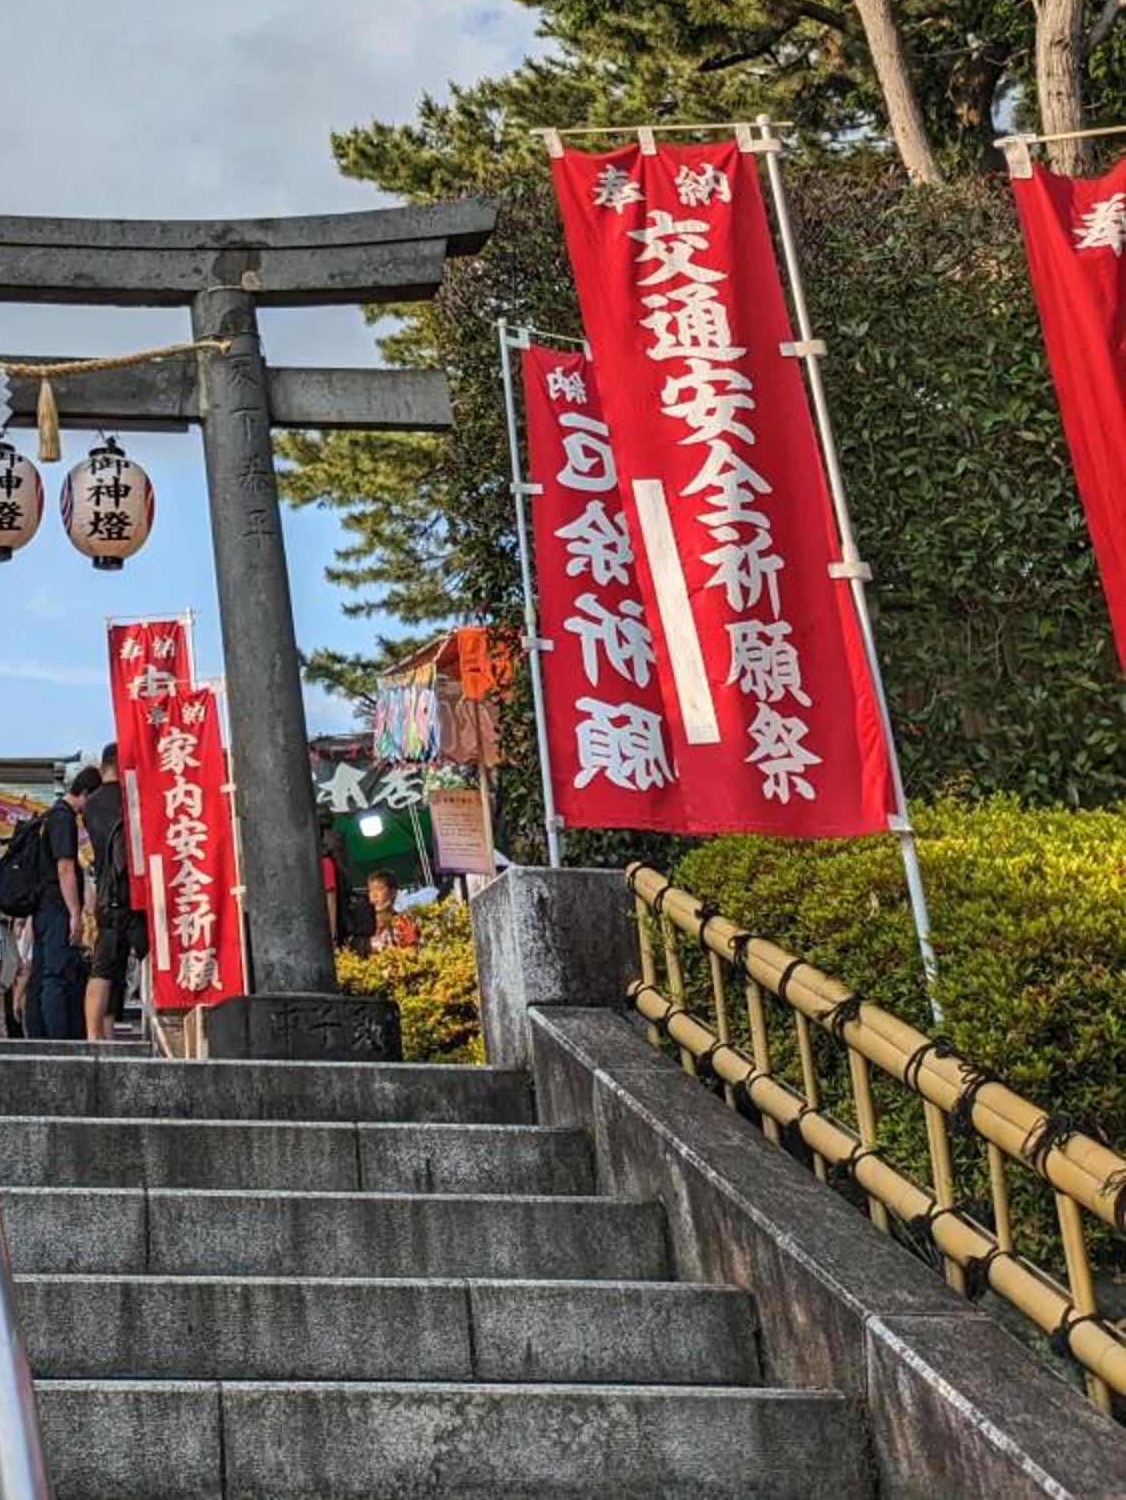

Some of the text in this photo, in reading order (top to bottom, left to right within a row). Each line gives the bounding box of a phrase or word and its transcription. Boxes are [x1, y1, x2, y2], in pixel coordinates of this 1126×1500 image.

[591, 162, 732, 214] 奉納
[87, 453, 133, 542] 御神燈
[627, 209, 822, 804] 交通安全祈願祭
[156, 726, 224, 992] 家内安全祈願
